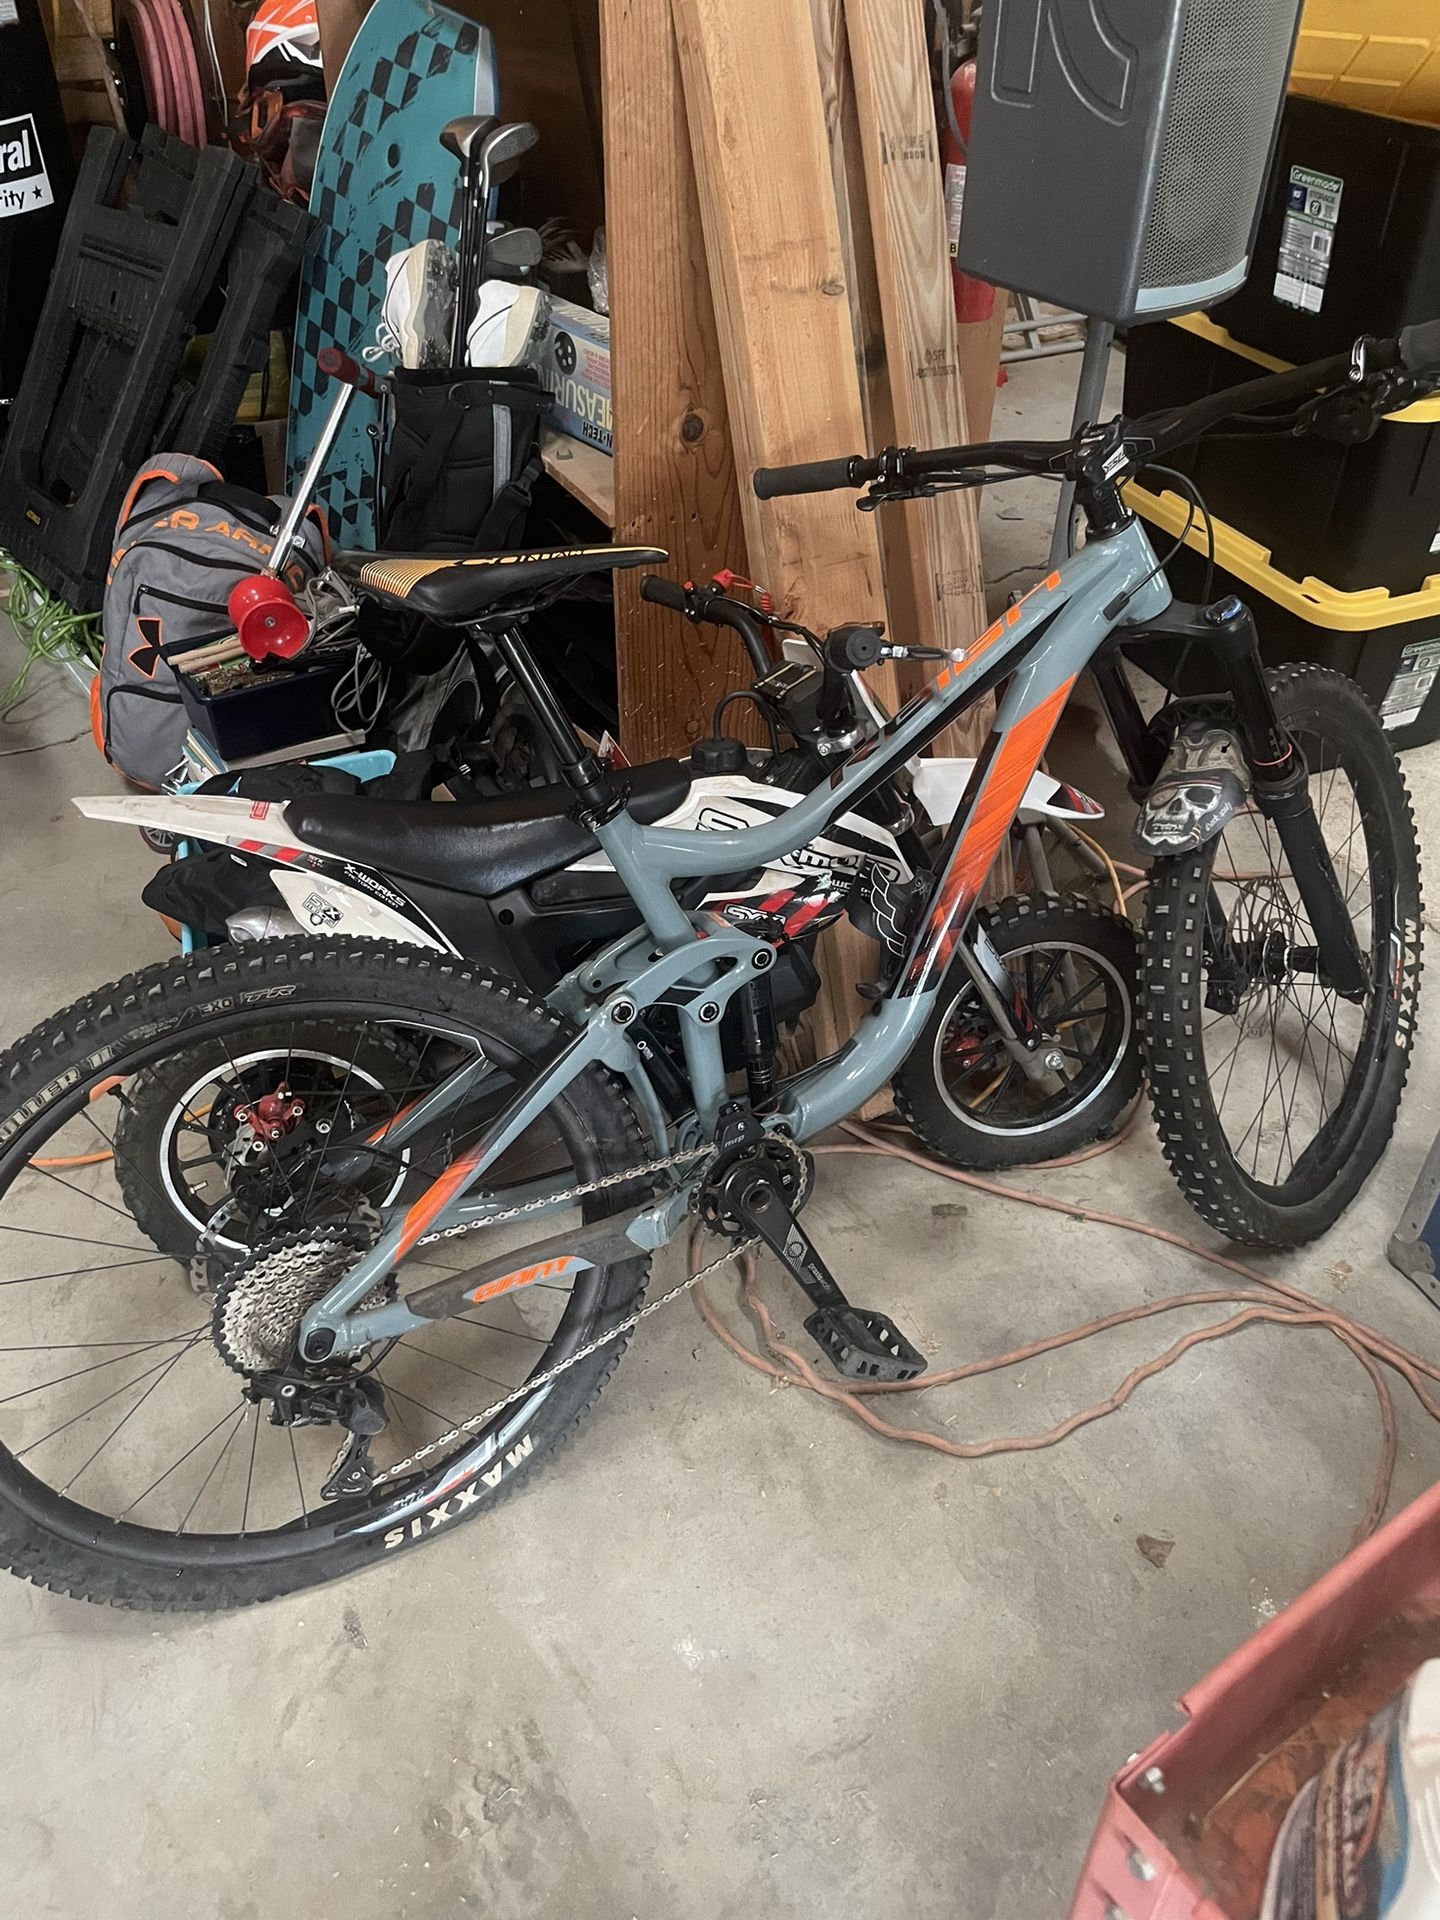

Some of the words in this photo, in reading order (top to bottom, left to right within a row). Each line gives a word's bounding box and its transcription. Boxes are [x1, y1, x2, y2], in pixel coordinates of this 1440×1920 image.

[343, 863, 407, 908] X-WORKS
[200, 997, 234, 1017] EXO
[1394, 918, 1417, 1050] MAXXIS
[383, 1433, 534, 1550] MAXXIS
